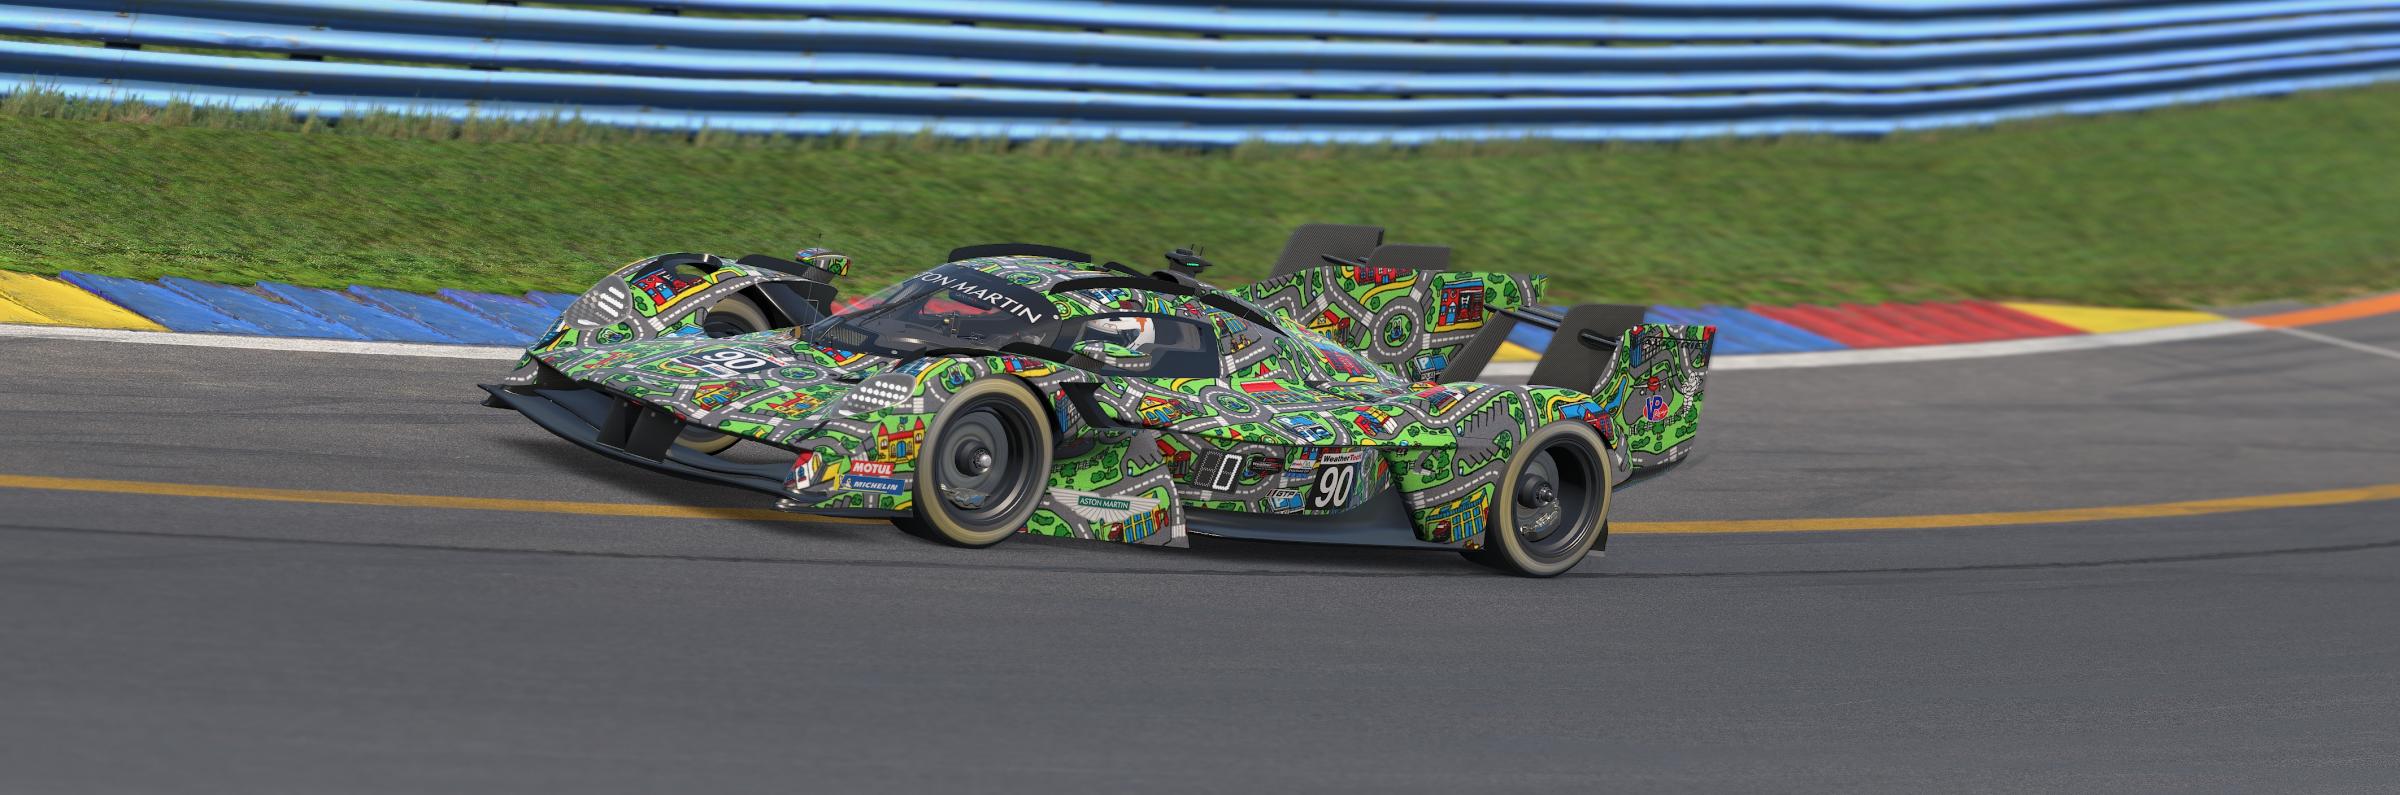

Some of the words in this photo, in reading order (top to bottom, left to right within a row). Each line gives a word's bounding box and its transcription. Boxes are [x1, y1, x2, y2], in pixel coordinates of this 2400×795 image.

[951, 281, 1042, 323] MARTIN
[702, 351, 767, 370] 90
[1646, 395, 1663, 421] VP
[852, 462, 891, 475] MOTUL
[853, 481, 899, 491] MICHELIN
[1276, 490, 1296, 498] GTP
[1314, 465, 1354, 508] 90
[1080, 498, 1102, 507] ASTON
[1103, 501, 1129, 510] MARTIN
